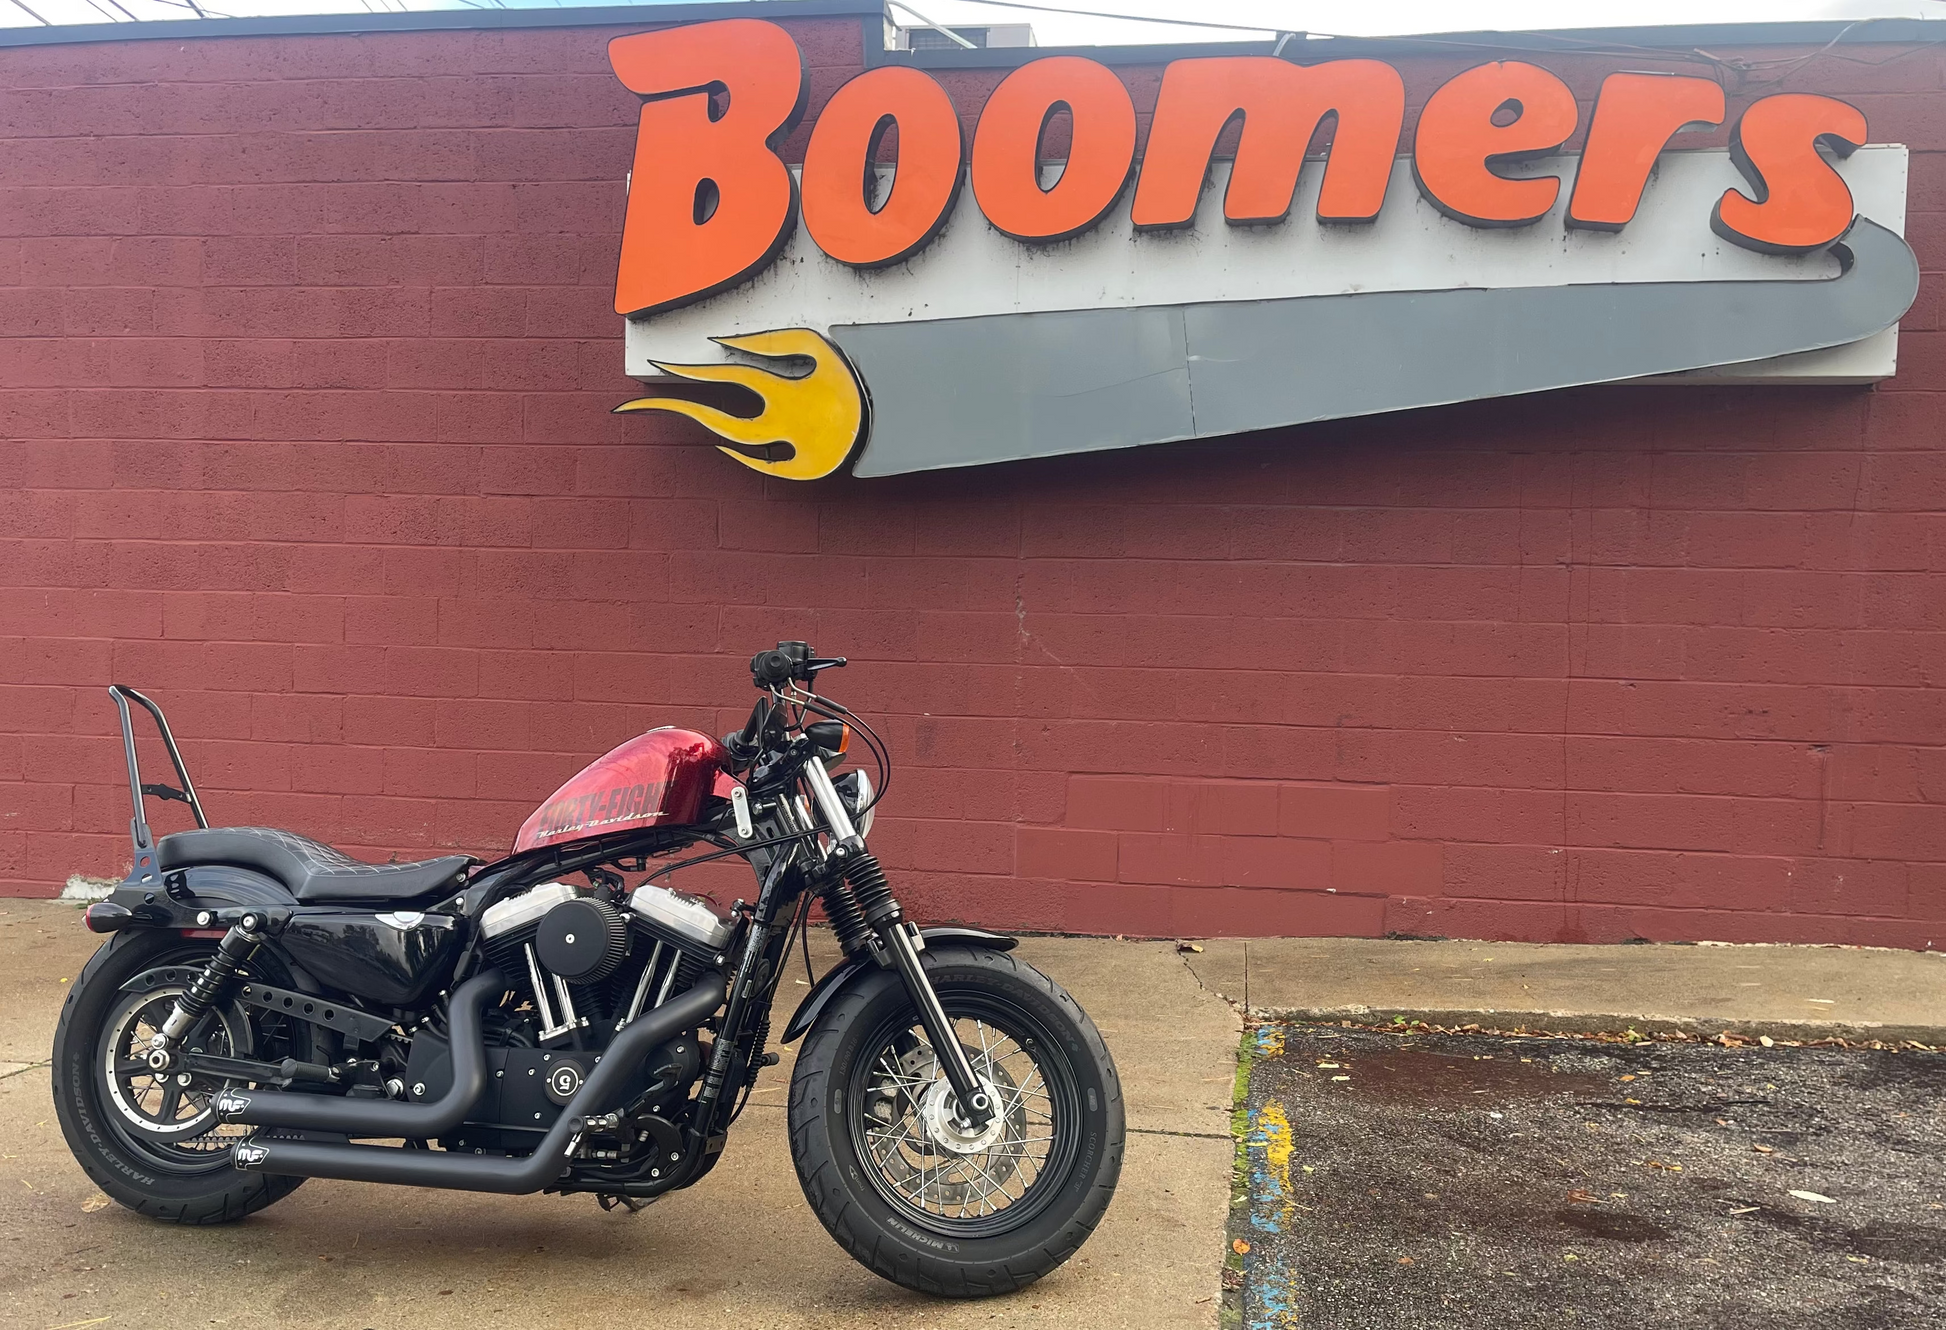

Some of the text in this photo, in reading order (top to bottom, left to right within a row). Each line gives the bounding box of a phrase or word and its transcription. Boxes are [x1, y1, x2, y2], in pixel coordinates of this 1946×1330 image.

[608, 17, 1869, 314] Boomers
[536, 811, 670, 839] Harley-Davidson
[72, 1064, 157, 1186] HARLEY-DAVIDSON
[1079, 1131, 1098, 1181] SCORCHER
[887, 1217, 944, 1249] MICHELIN
